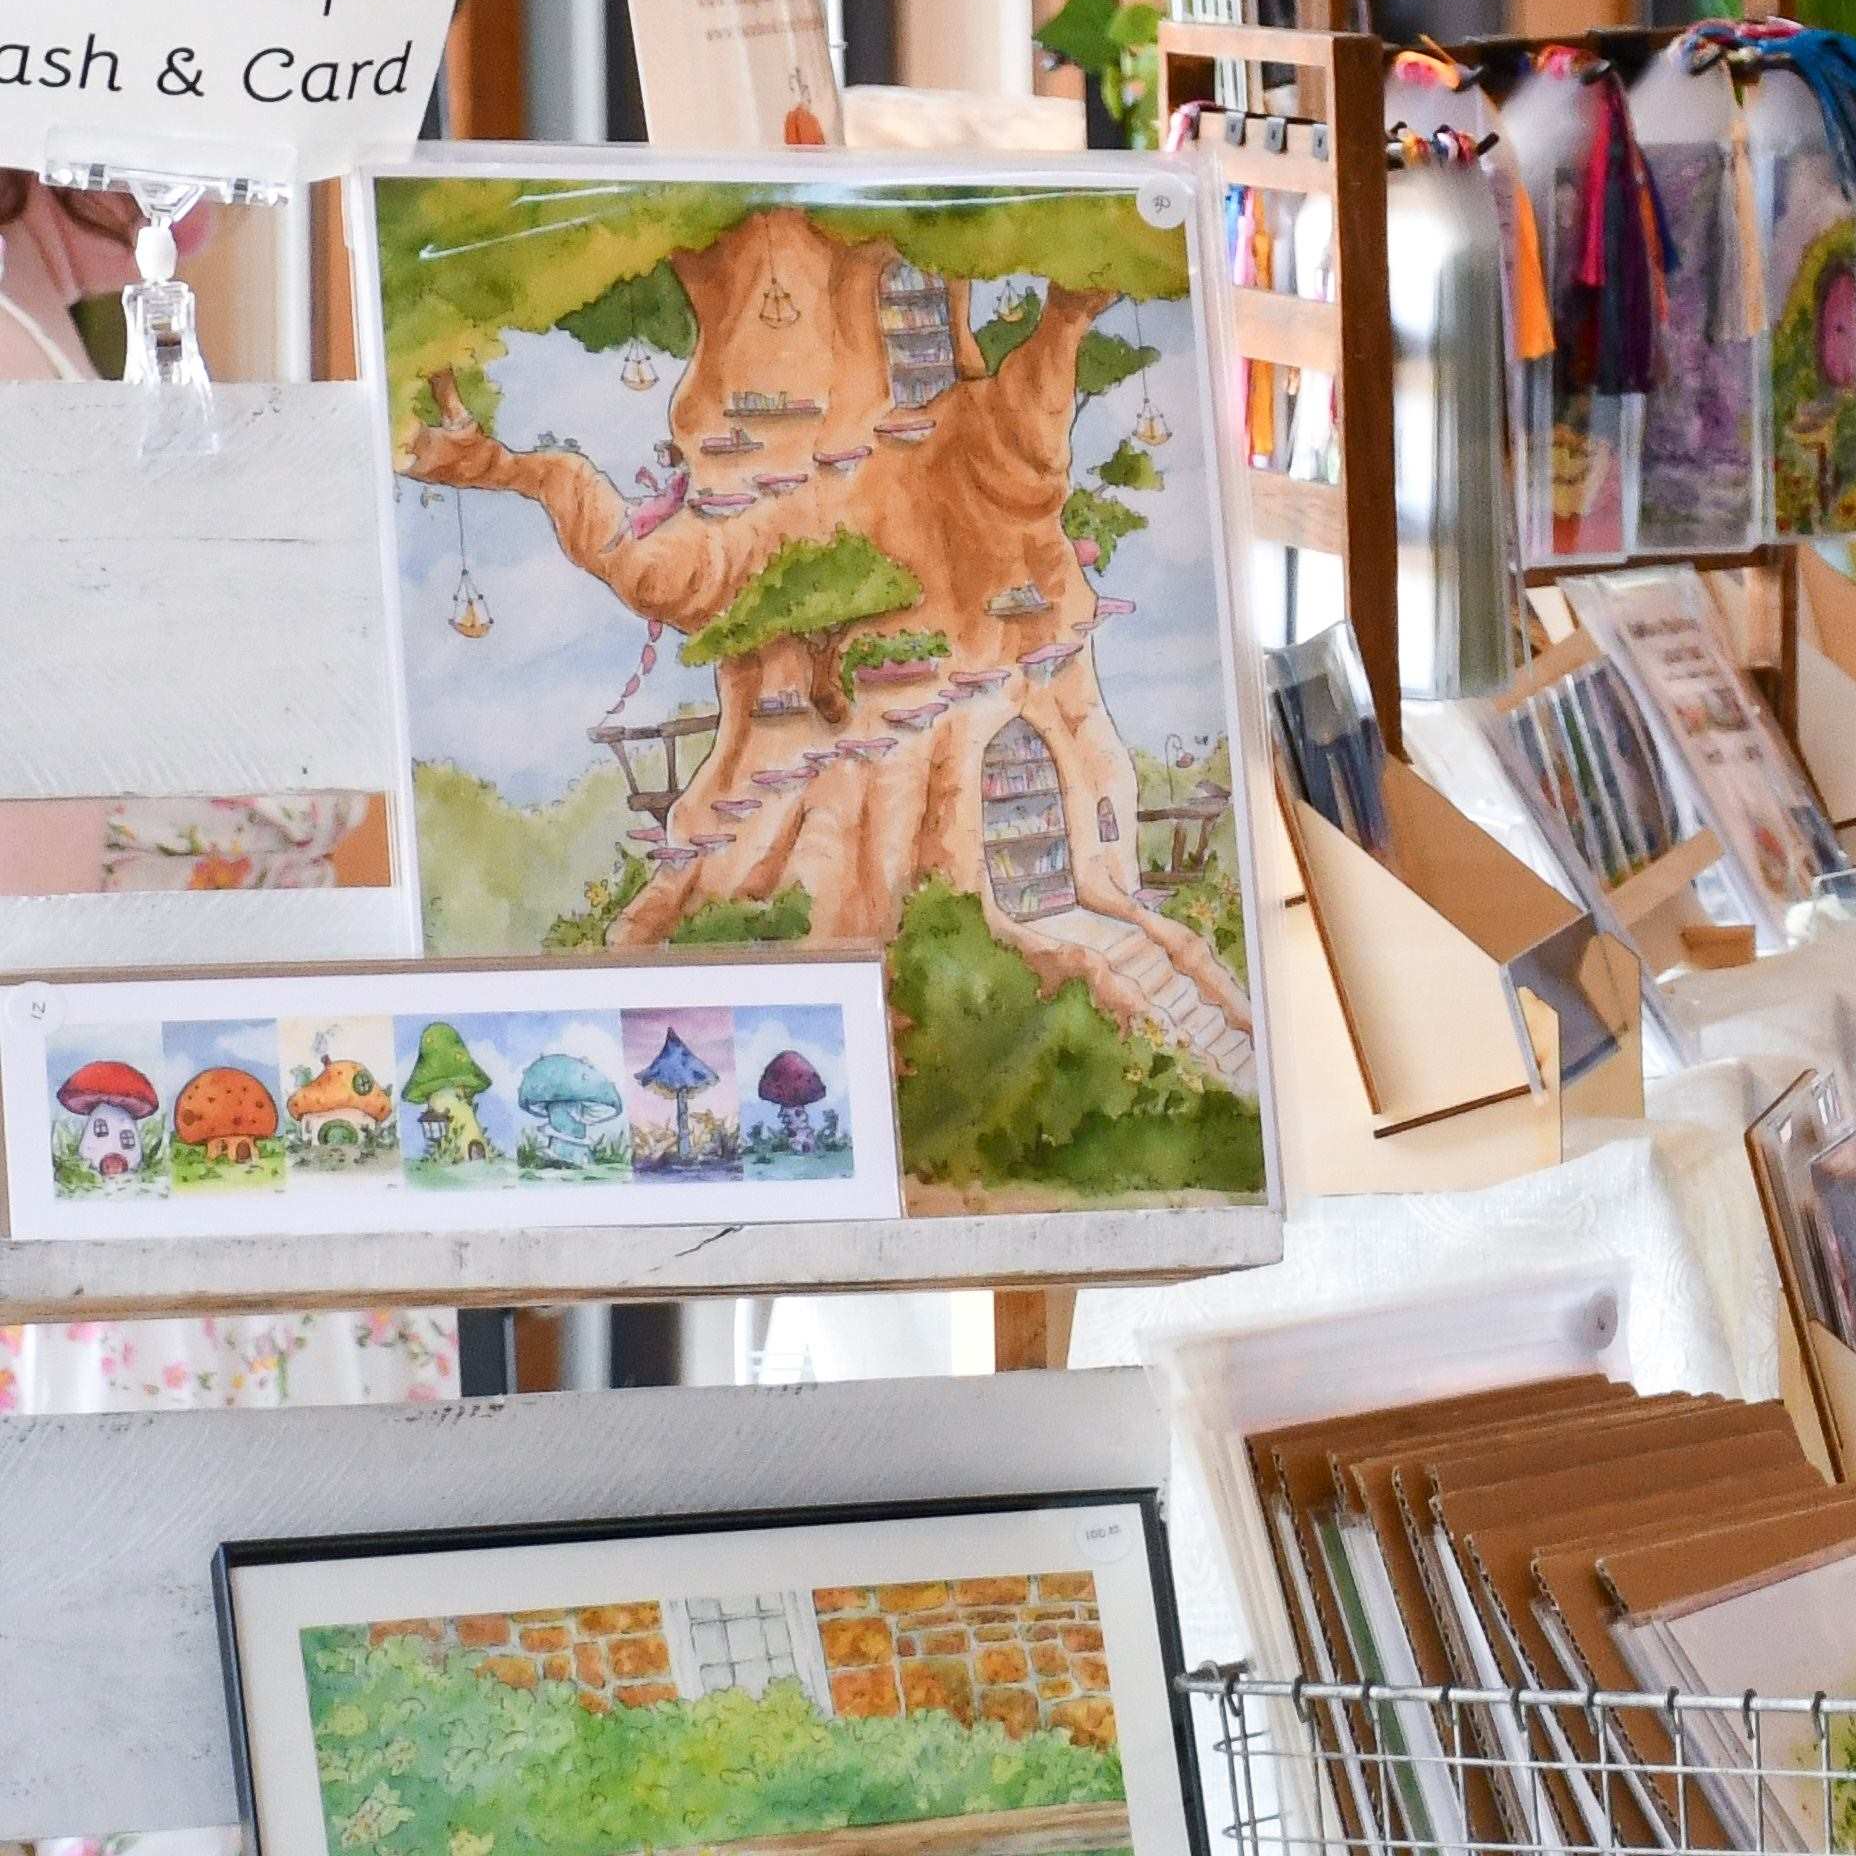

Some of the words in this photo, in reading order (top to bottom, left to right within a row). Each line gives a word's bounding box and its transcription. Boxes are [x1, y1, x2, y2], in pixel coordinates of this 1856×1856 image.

[0, 33, 123, 92] ash
[156, 46, 205, 97] &
[243, 39, 413, 103] Card
